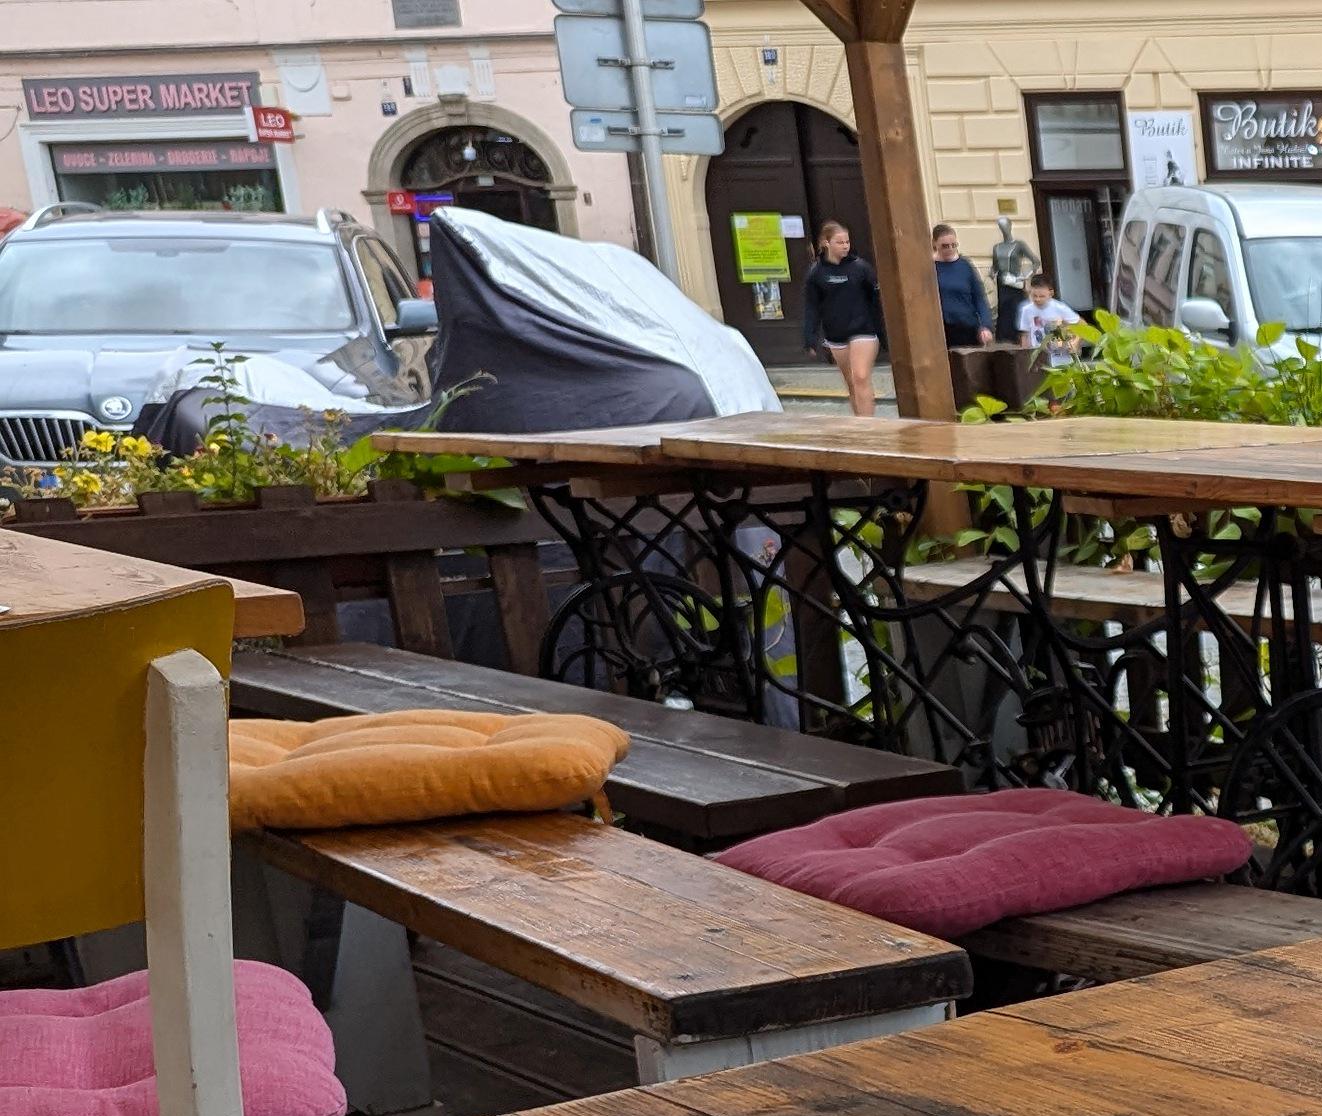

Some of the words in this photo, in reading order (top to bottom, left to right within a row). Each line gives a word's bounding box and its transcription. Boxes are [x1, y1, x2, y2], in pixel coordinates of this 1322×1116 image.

[30, 86, 75, 113] LEO
[79, 85, 154, 112] SUPER
[159, 81, 251, 109] MARKET
[260, 112, 285, 128] LEO
[1135, 118, 1188, 138] Butik
[1217, 101, 1318, 140] Butik
[1232, 156, 1314, 169] INFINITE
